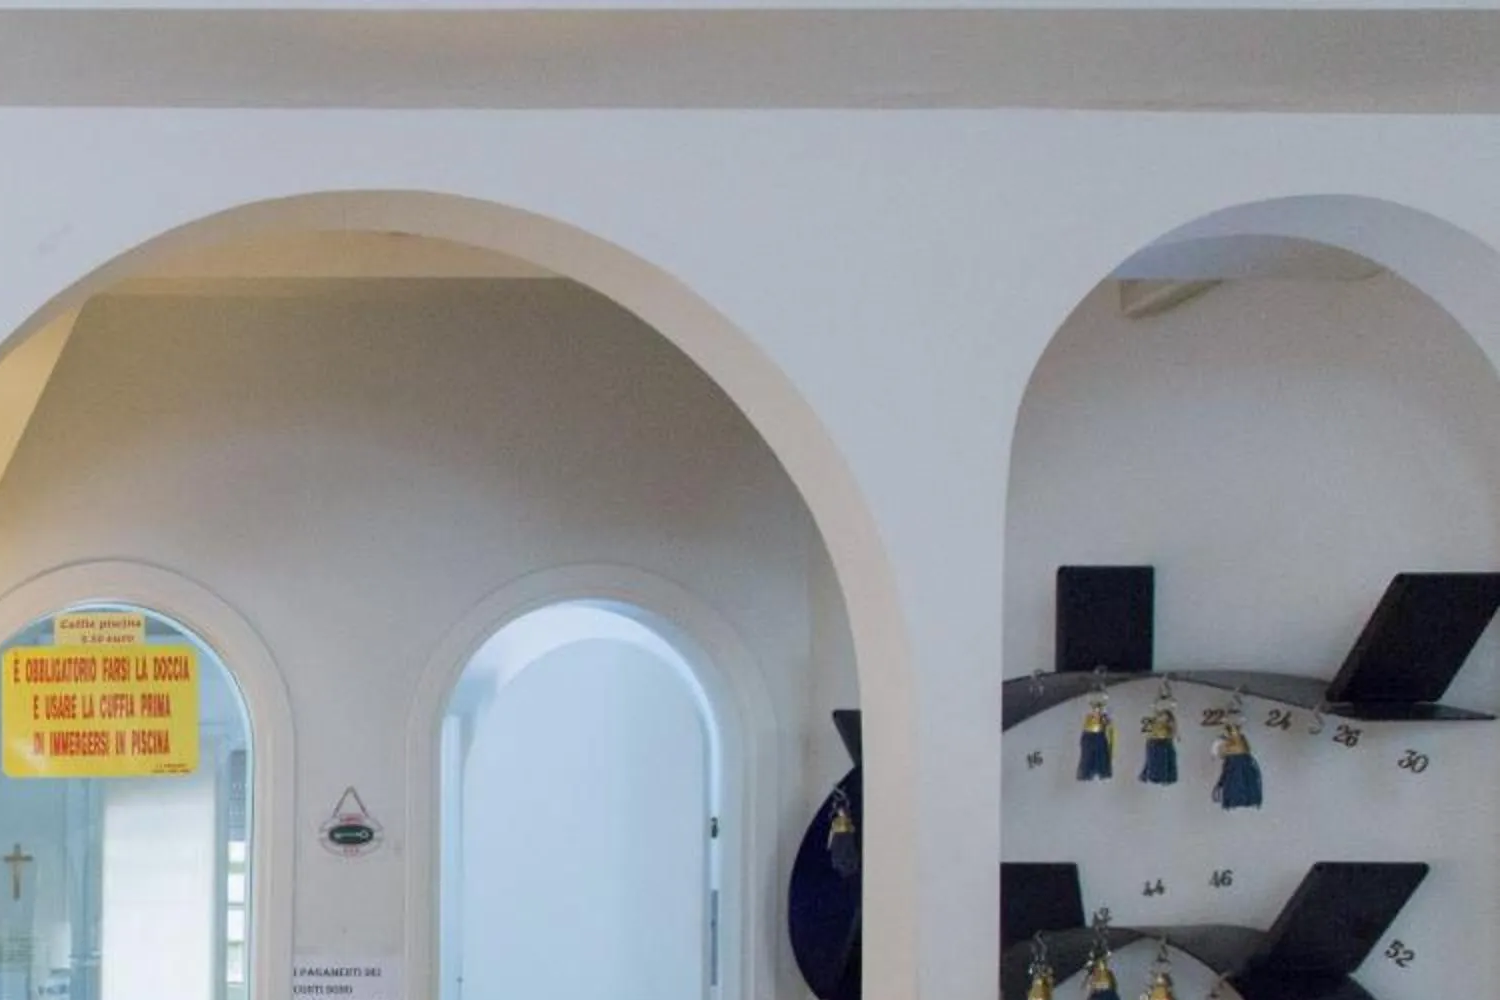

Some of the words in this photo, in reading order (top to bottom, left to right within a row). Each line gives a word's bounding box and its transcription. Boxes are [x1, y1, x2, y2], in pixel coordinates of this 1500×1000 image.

[25, 657, 97, 683] OBBLIGATORIO
[102, 656, 131, 683] FARSI
[135, 656, 149, 682] LA
[153, 656, 190, 682] DOCCIA
[33, 695, 40, 720] E
[45, 694, 77, 720] USARE
[82, 694, 95, 719] LA
[99, 693, 136, 719] CUFFIA
[141, 693, 172, 718] PRIMA
[1201, 708, 1226, 728] 22
[1264, 708, 1293, 731] 24
[33, 731, 45, 756] DI
[50, 731, 111, 756] IMMERGERSI
[115, 731, 127, 756] IN
[131, 730, 171, 755] PISCINA
[1397, 748, 1430, 775] 30
[1384, 939, 1415, 969] 52
[299, 967, 362, 977] PAGAMENTI
